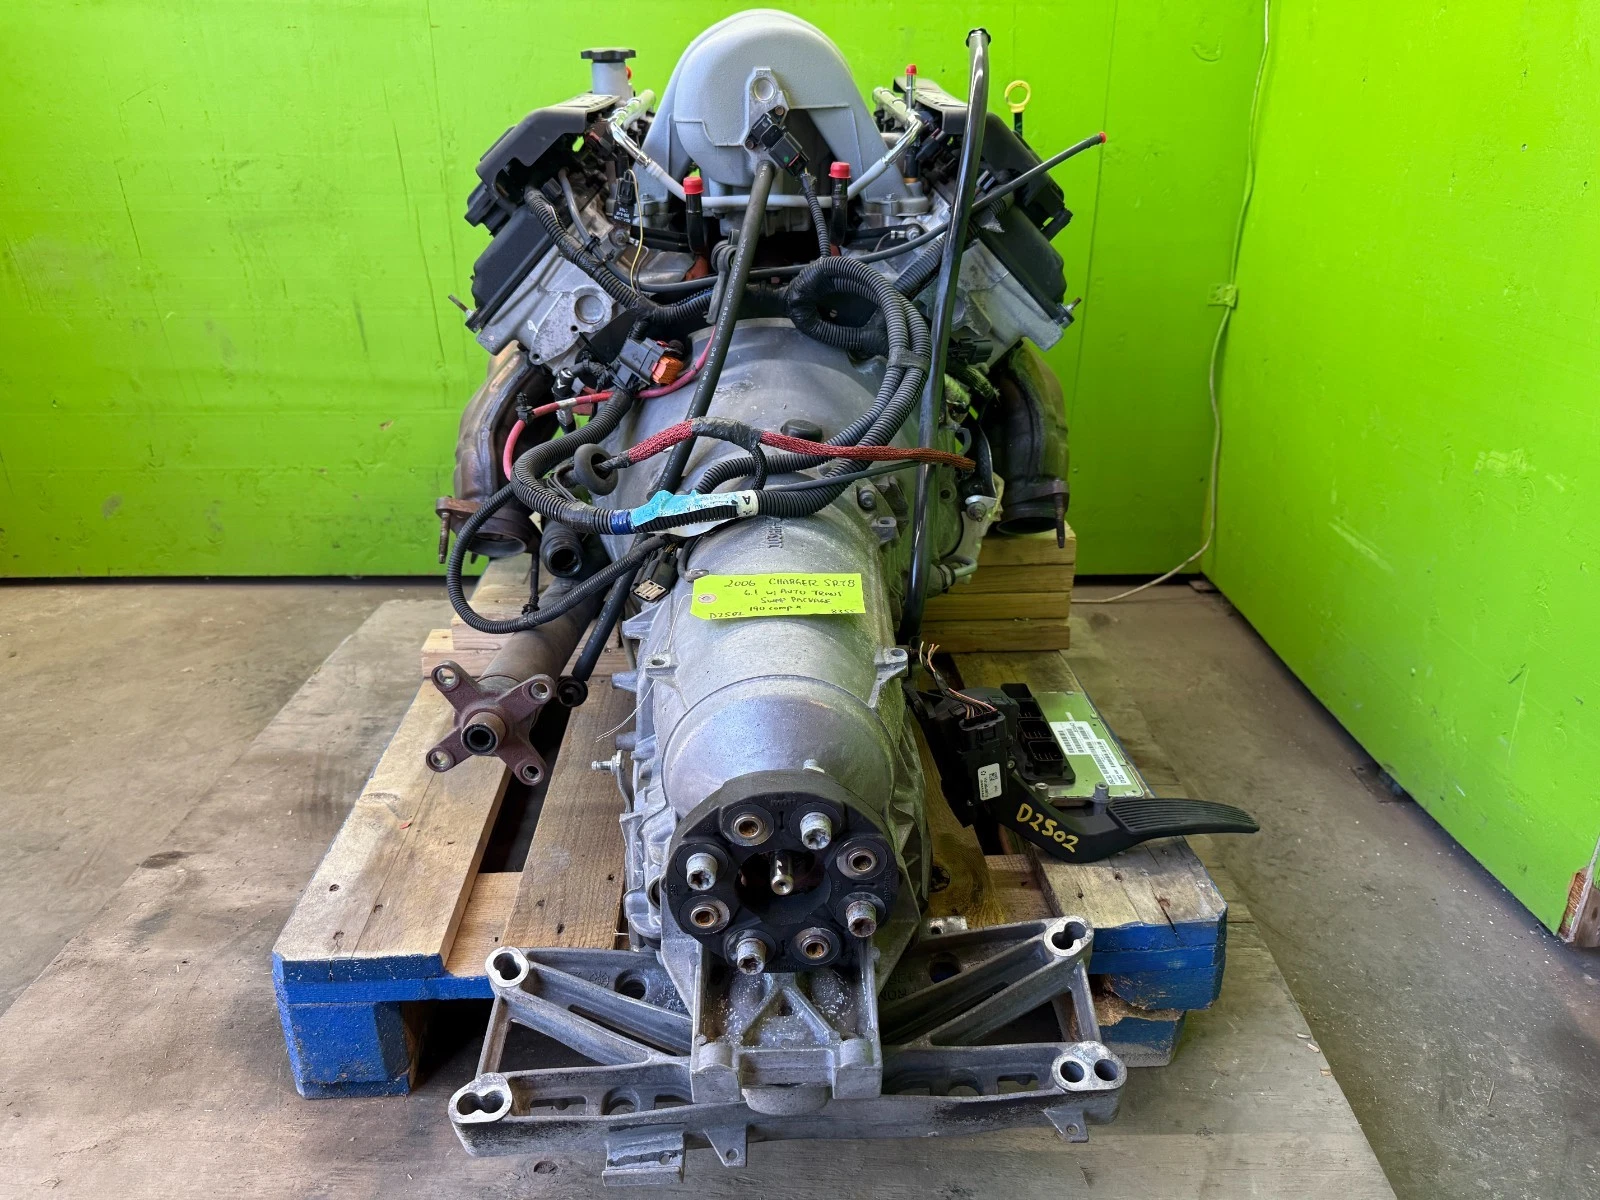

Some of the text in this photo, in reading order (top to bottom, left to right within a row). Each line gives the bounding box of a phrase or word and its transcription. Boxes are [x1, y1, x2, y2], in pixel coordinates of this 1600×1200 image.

[723, 577, 856, 588] 2006 CHARGER SRT8
[780, 588, 807, 596] AUTO
[790, 596, 832, 604] PACKAGE
[1015, 802, 1080, 853] D2502
